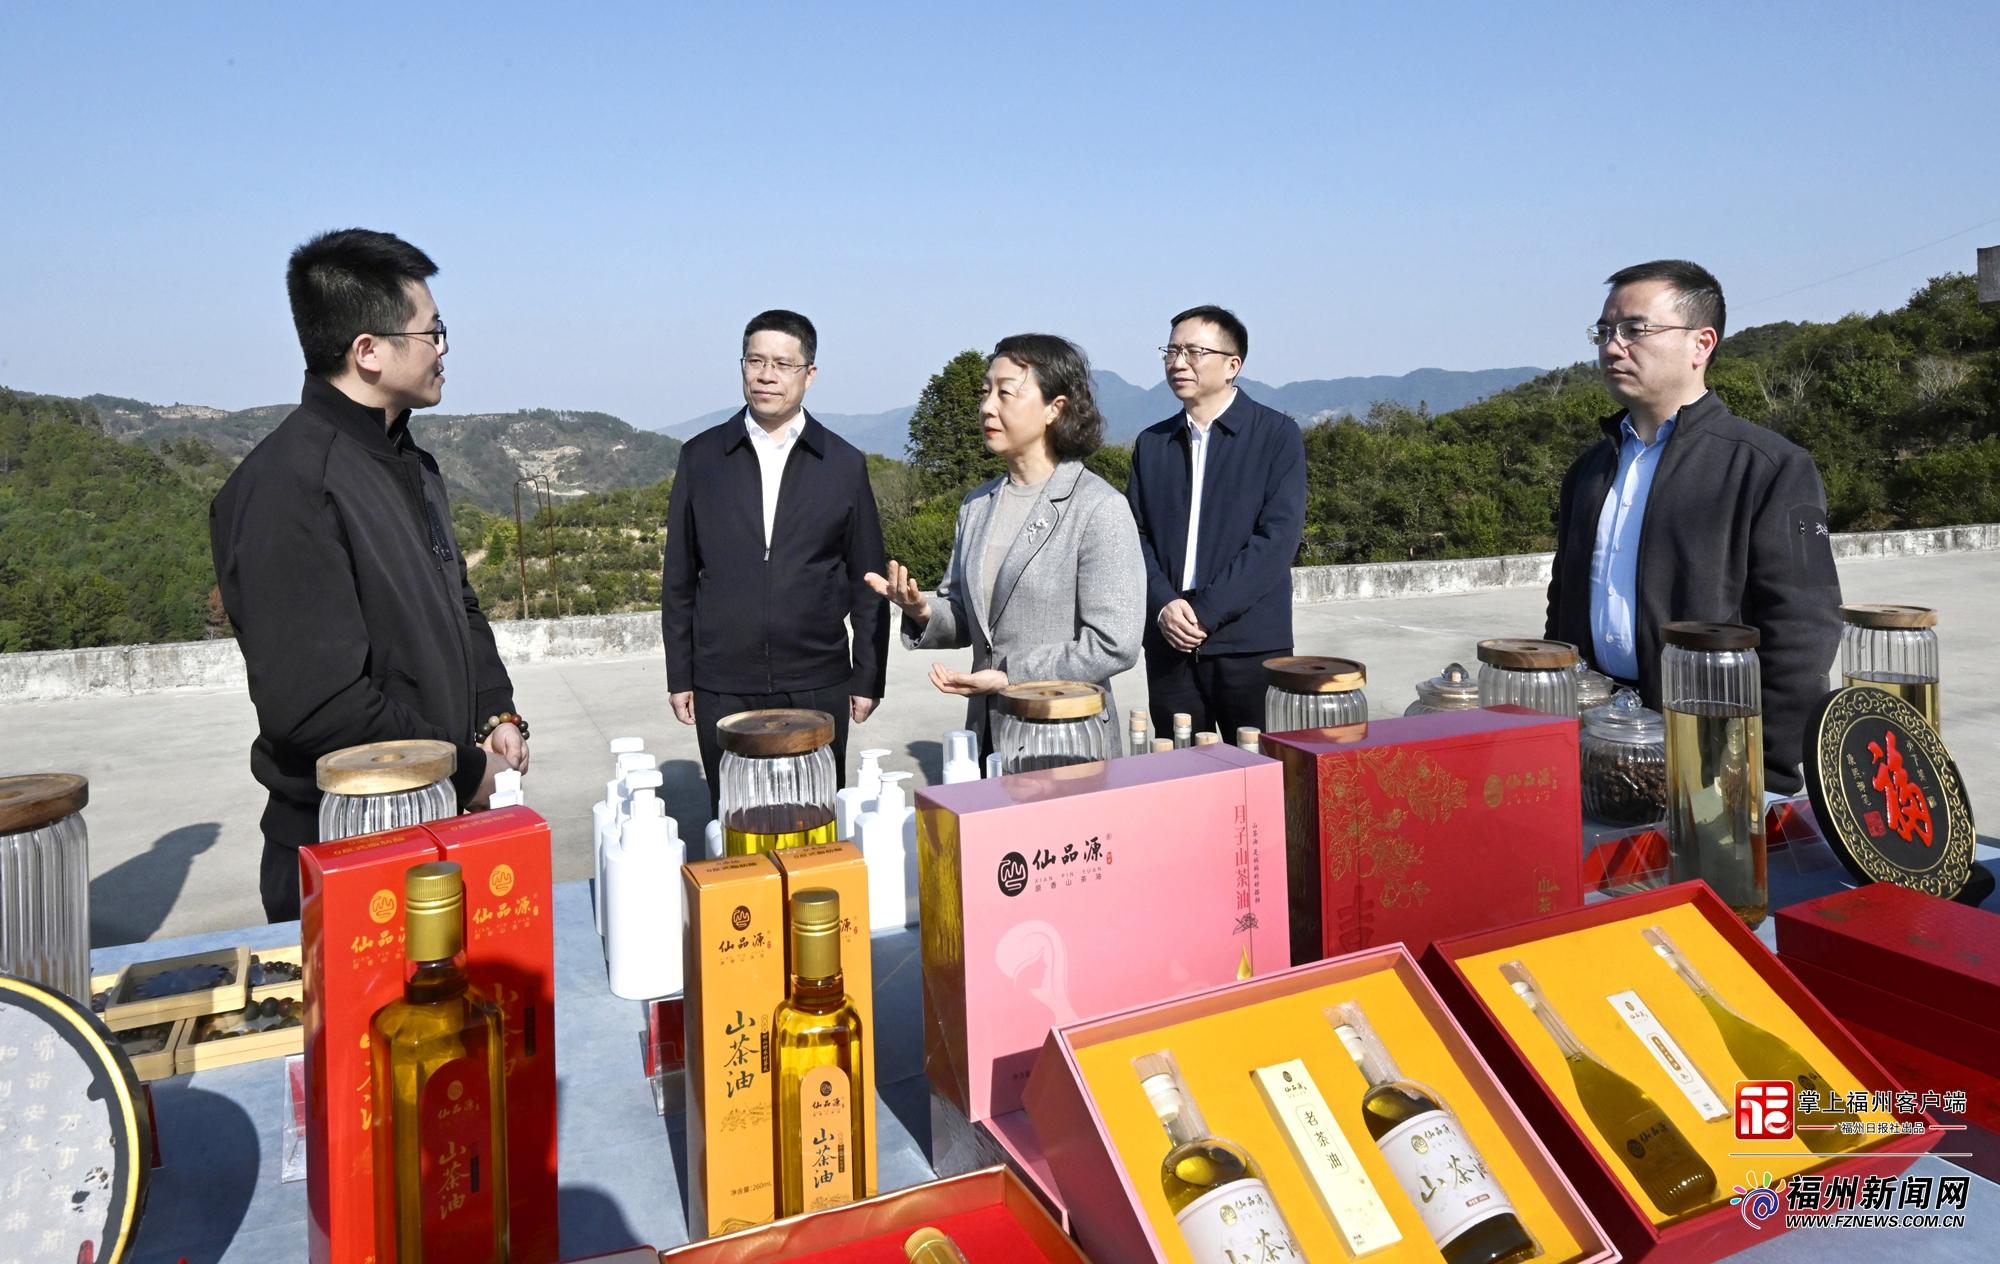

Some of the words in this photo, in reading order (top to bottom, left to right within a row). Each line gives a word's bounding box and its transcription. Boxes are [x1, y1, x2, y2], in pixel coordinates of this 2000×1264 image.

[1031, 836, 1104, 871] 仙品源
[471, 896, 531, 925] 仙品源
[718, 931, 767, 954] 仙品源
[724, 1010, 760, 1098] 山茶油
[812, 1127, 838, 1189] 山茶油
[1304, 1110, 1343, 1170] 老茶油
[437, 1140, 471, 1220] 山茶油
